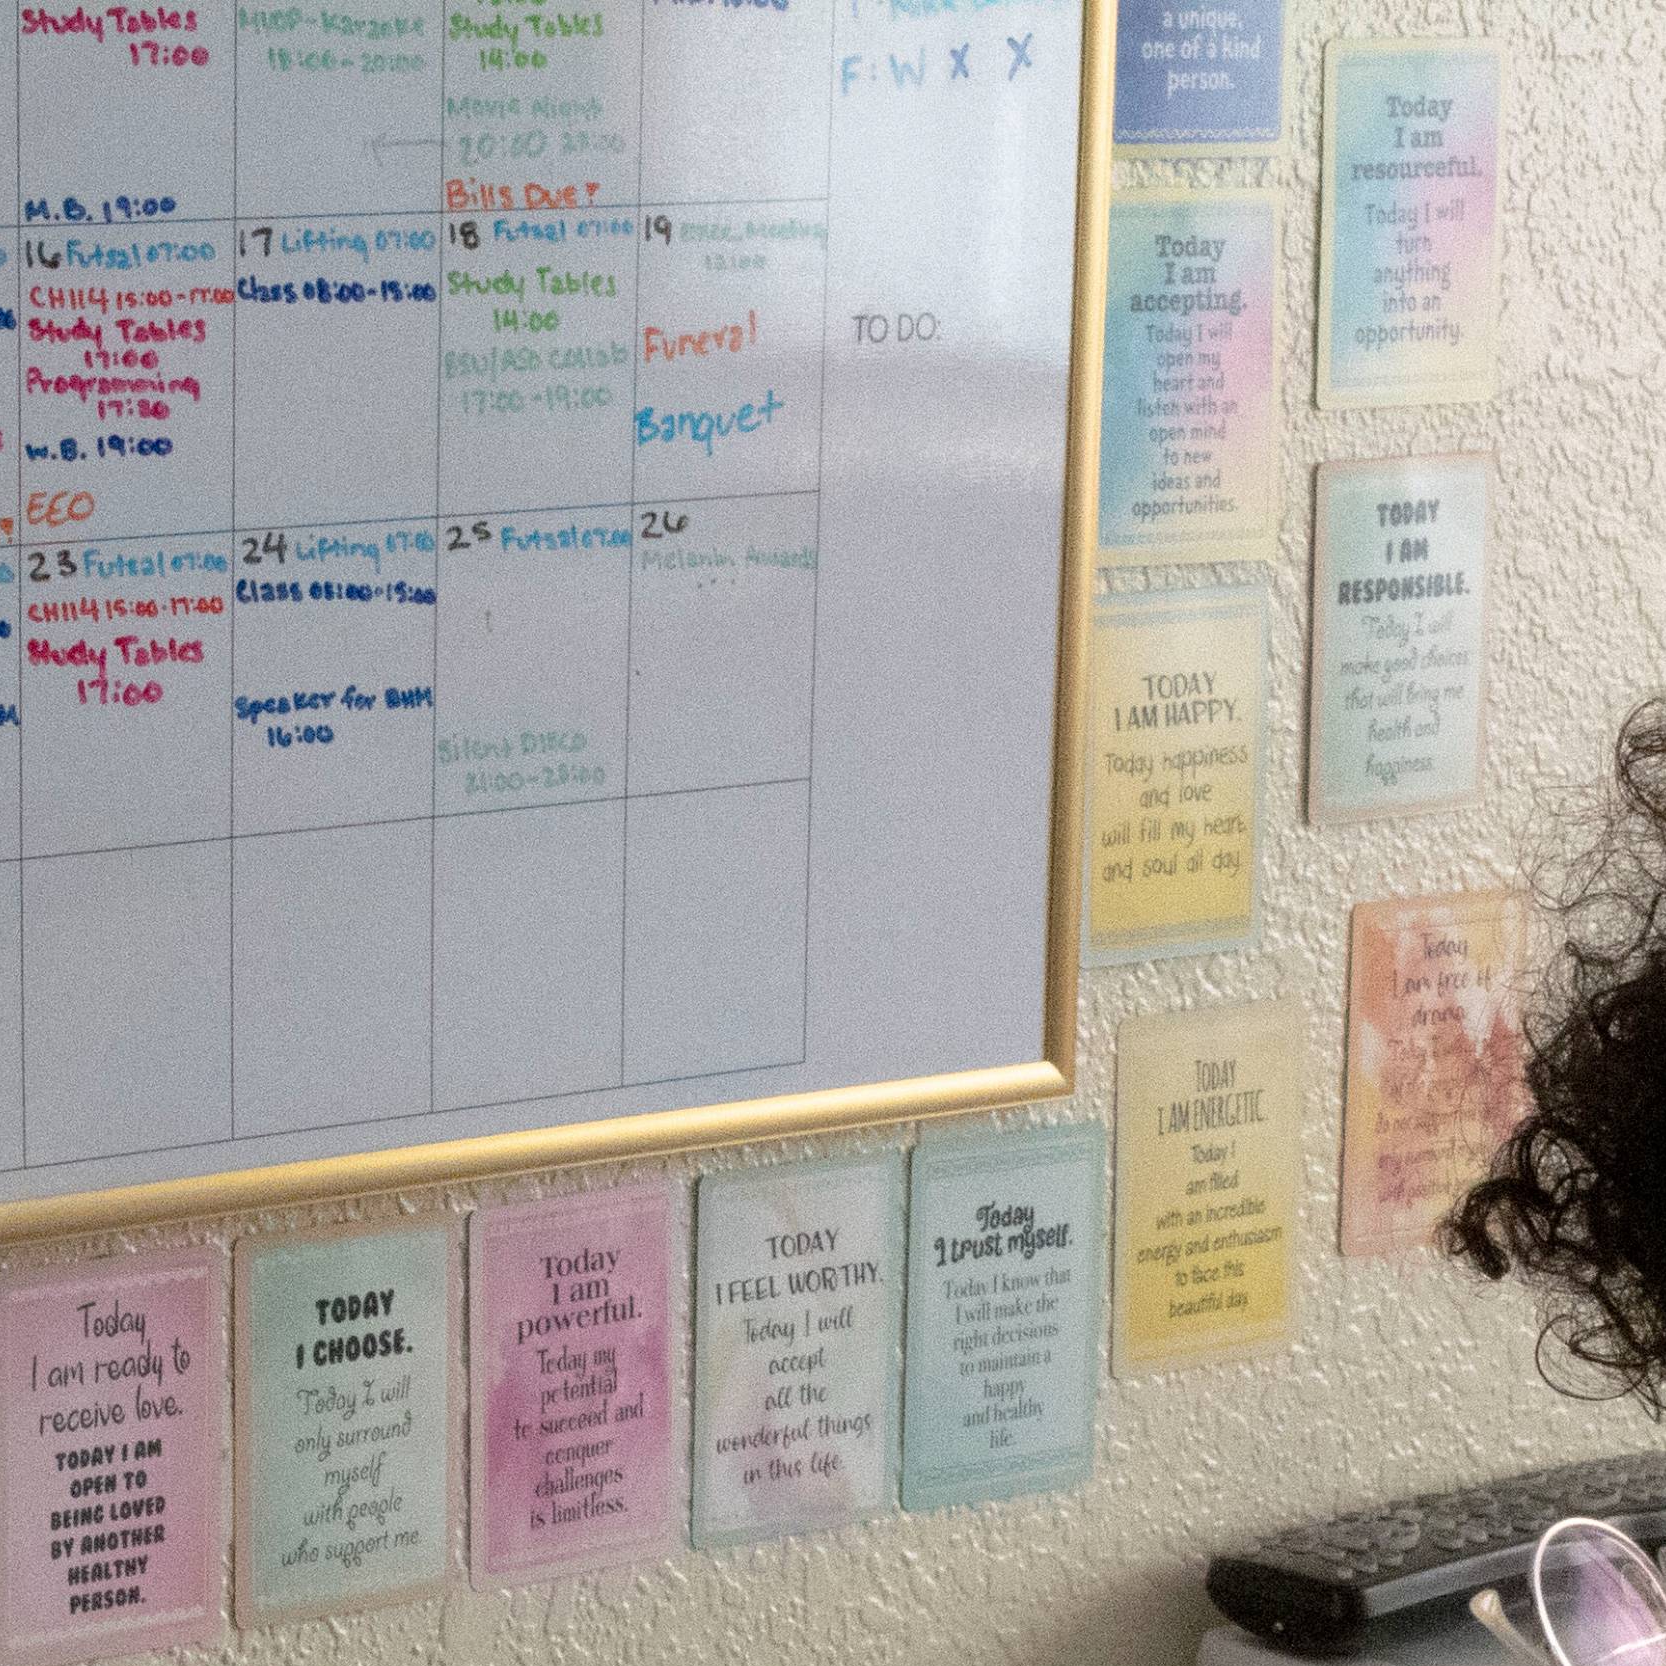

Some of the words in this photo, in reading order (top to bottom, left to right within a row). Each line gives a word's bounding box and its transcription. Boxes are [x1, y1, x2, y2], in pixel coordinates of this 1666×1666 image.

[1386, 95, 1453, 122] Today
[1351, 157, 1483, 182] resourceful.
[239, 226, 273, 257] 17
[450, 221, 480, 249] 18
[644, 215, 672, 246] 19
[26, 240, 60, 269] 16
[1155, 234, 1226, 265] Today
[1130, 289, 1247, 315] accepting.
[28, 317, 102, 349] Study
[116, 318, 206, 342] Tables
[644, 309, 757, 363] Funeral
[852, 314, 888, 343] TO
[897, 312, 941, 342] DO:
[636, 390, 784, 457] Banquet
[641, 511, 689, 538] 26
[1376, 500, 1440, 527] TODAY
[242, 532, 288, 564] 24
[447, 522, 491, 551] 25
[1385, 538, 1392, 562] I
[1399, 536, 1429, 562] AM
[28, 549, 77, 582] 23
[1337, 573, 1469, 605] RESPONSIBLE.
[1141, 672, 1217, 698] TODAY
[1113, 707, 1121, 731] I
[1125, 705, 1158, 729] AM
[1165, 698, 1241, 724] HAPPY.
[267, 725, 334, 747] 16:00
[1195, 1059, 1237, 1093] TODAY
[1158, 1108, 1164, 1135] I
[1168, 1105, 1190, 1134] AM
[976, 1201, 1034, 1234] Today
[765, 1229, 840, 1260] TODAY
[934, 1237, 947, 1267] I
[952, 1234, 1002, 1262] trust
[1007, 1223, 1072, 1260] myself.
[540, 1247, 621, 1281] Today
[552, 1283, 559, 1305] I
[570, 1278, 609, 1303] am
[716, 1282, 722, 1306] I
[729, 1277, 779, 1306] FEEL
[789, 1261, 883, 1294] WORTHY.
[77, 1300, 147, 1340] Today
[315, 1289, 394, 1326] TODAY
[516, 1296, 642, 1344] powerful.
[296, 1344, 304, 1370] I
[313, 1327, 412, 1366] CHOOSE.
[51, 1501, 105, 1531] BEING
[110, 1496, 166, 1523] LOVED
[67, 1555, 148, 1587] HEALTHY
[70, 1586, 146, 1616] PERSON.
